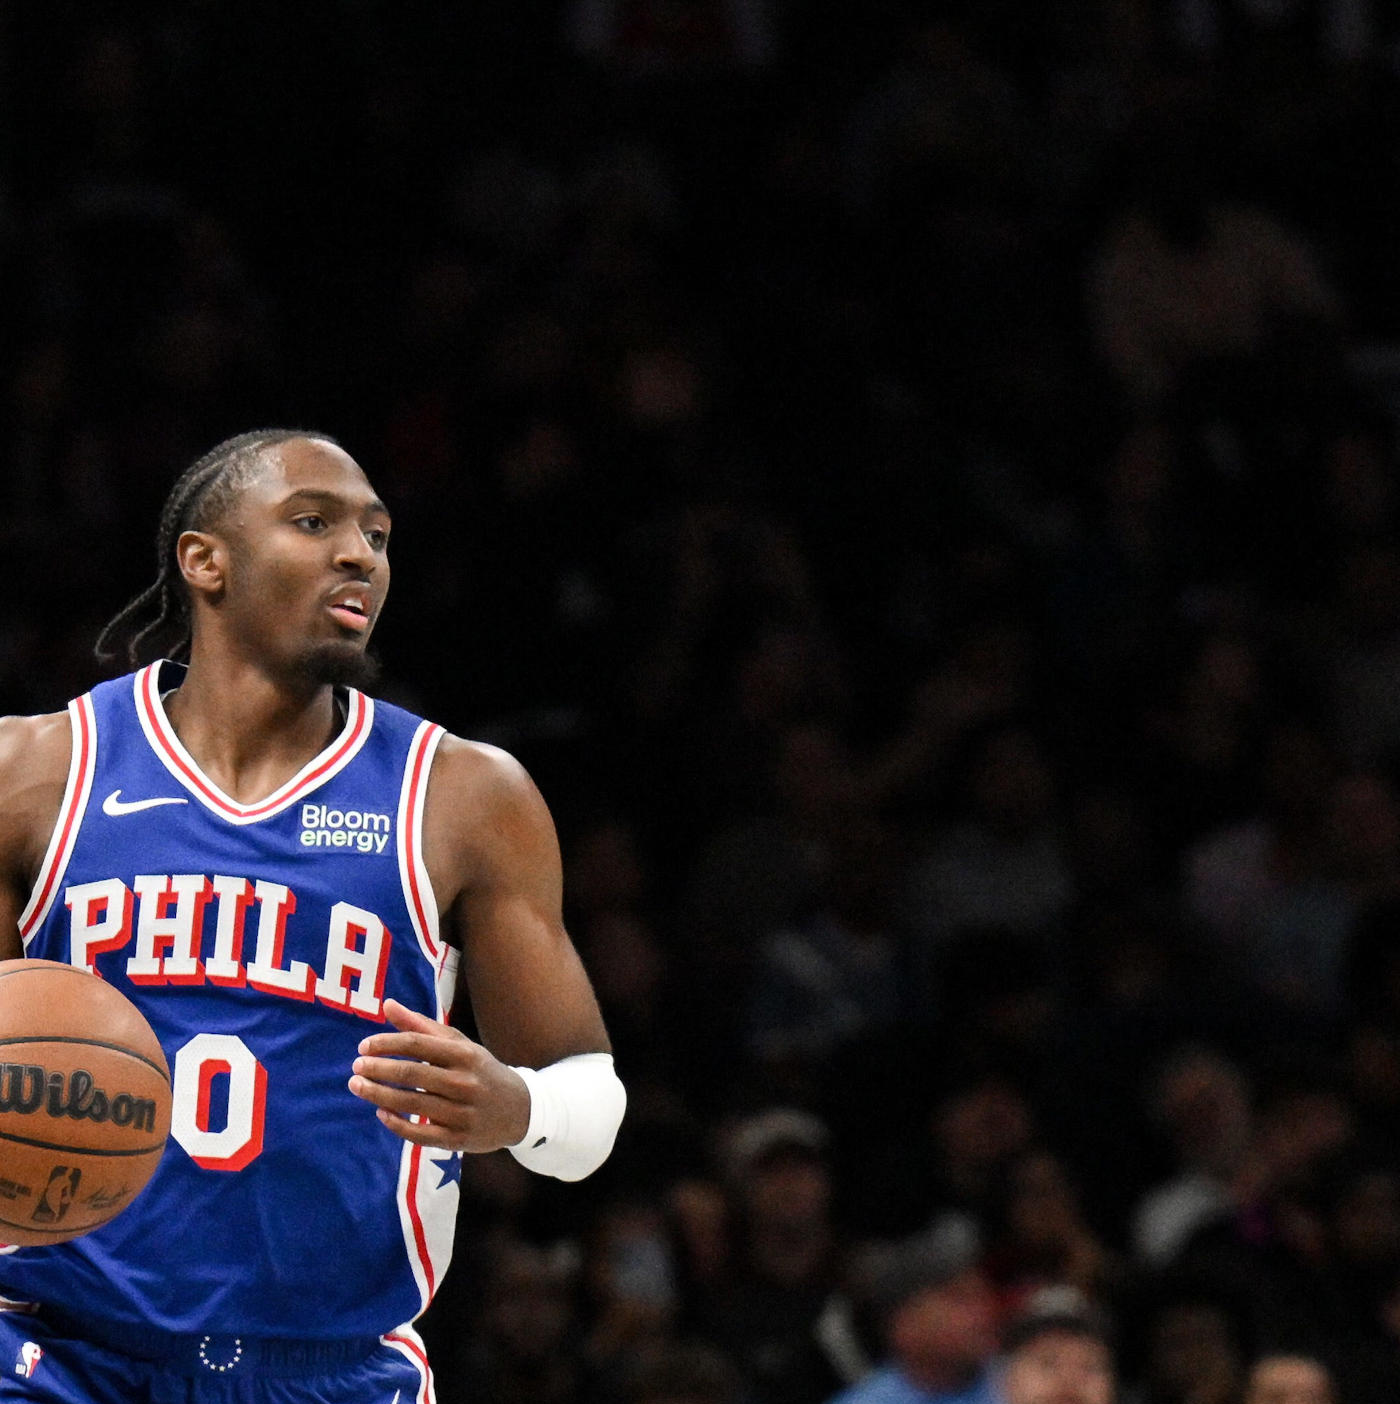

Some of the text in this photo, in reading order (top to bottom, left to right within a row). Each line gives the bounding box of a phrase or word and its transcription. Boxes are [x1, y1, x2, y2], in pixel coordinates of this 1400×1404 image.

[300, 829, 389, 853] energy
[302, 804, 390, 832] Bloom
[64, 873, 392, 1023] PHILA
[170, 1033, 268, 1171] 0
